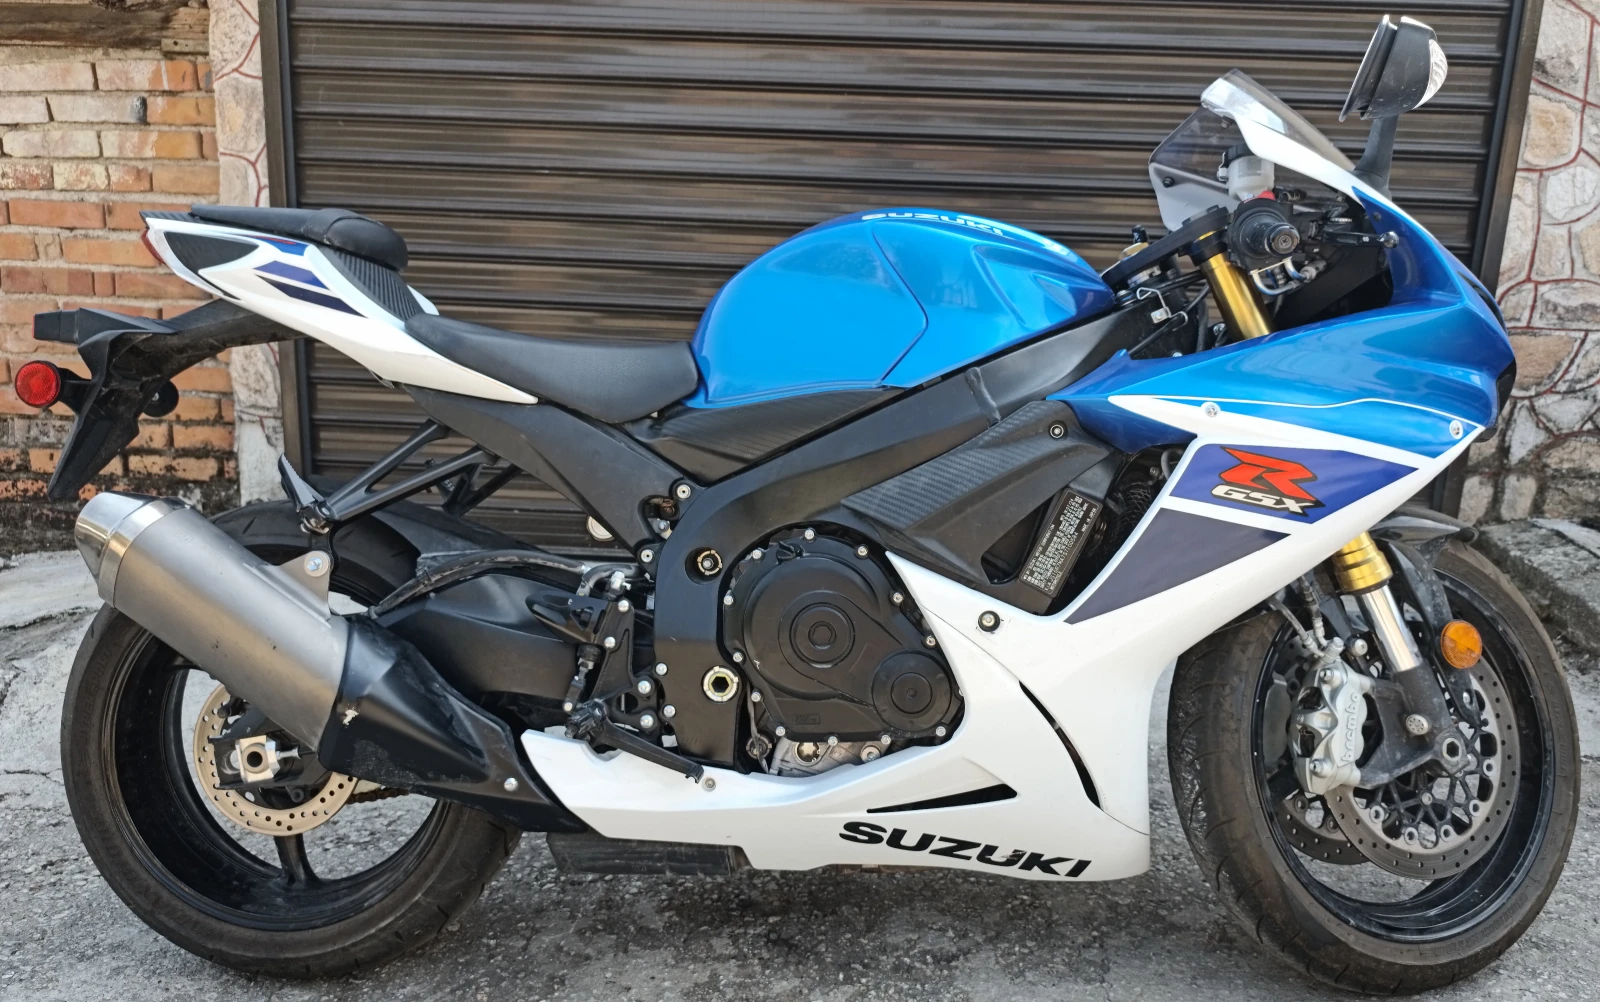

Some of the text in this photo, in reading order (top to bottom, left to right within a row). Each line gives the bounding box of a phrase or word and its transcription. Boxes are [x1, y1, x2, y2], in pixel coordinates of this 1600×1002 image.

[861, 212, 1004, 236] SUZUKI
[1210, 484, 1315, 514] GSX
[1341, 691, 1358, 762] brembo
[838, 821, 1092, 878] SUZUKI
